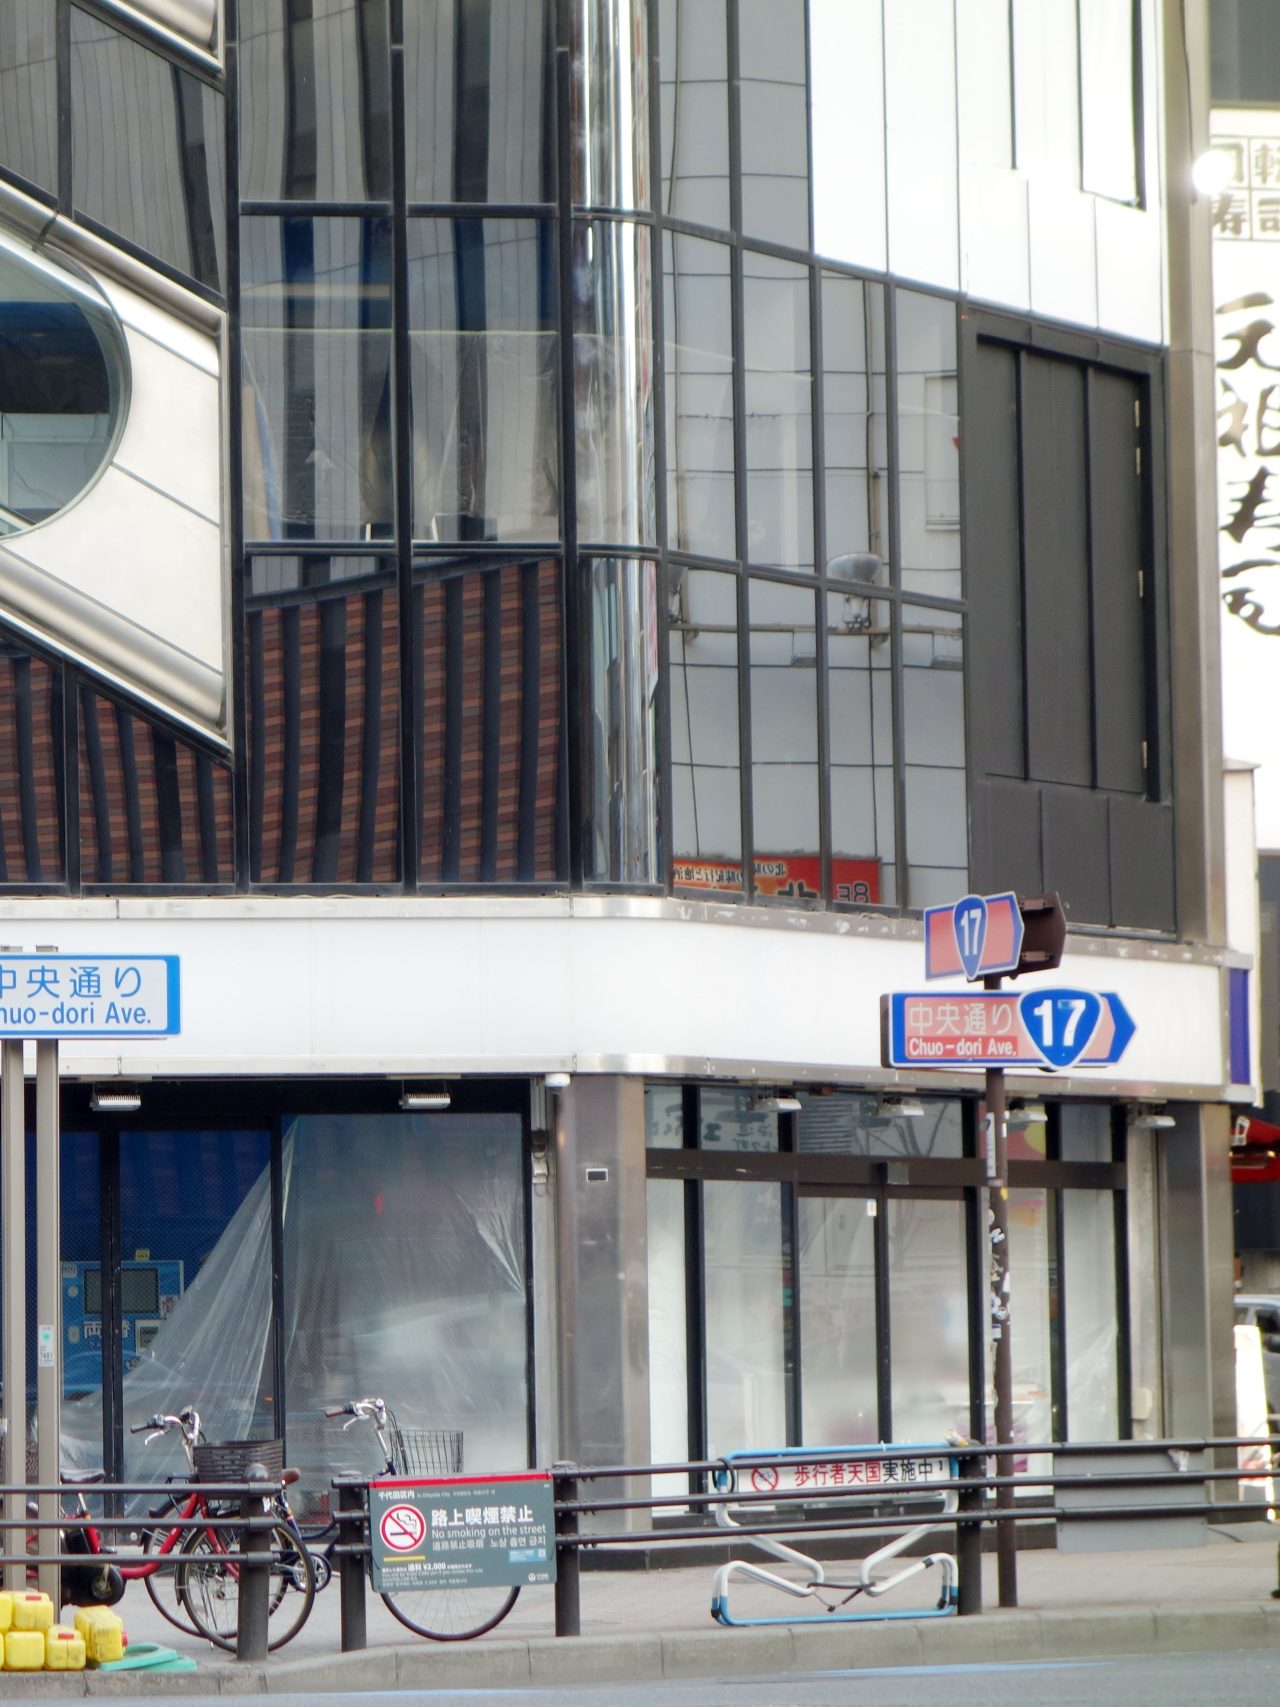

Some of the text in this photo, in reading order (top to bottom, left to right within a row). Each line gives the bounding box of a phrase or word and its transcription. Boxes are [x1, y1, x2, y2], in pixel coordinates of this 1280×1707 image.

[960, 909, 983, 956] 17
[105, 1002, 152, 1025] Ave.
[909, 1002, 1013, 1036] 中央通り
[1034, 999, 1086, 1047] 17
[909, 1037, 983, 1057] Chuo-dori
[431, 1504, 534, 1527] 路上喫煙禁止
[432, 1524, 547, 1541] No smoking on the street
